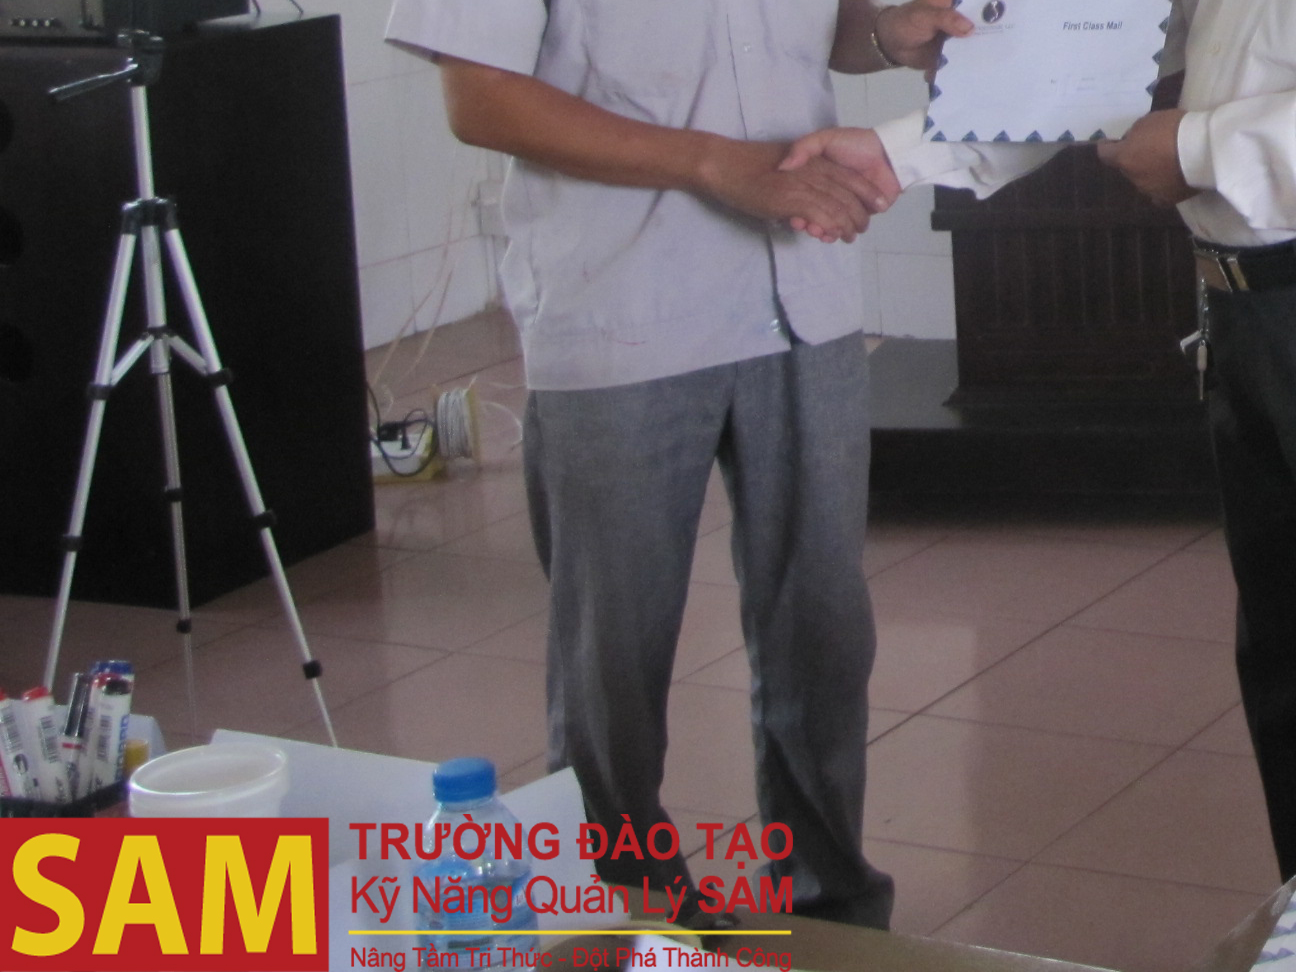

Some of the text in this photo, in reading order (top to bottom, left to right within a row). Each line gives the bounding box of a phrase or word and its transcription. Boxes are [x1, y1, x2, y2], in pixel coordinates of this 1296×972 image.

[1063, 20, 1123, 31] First Class Mail
